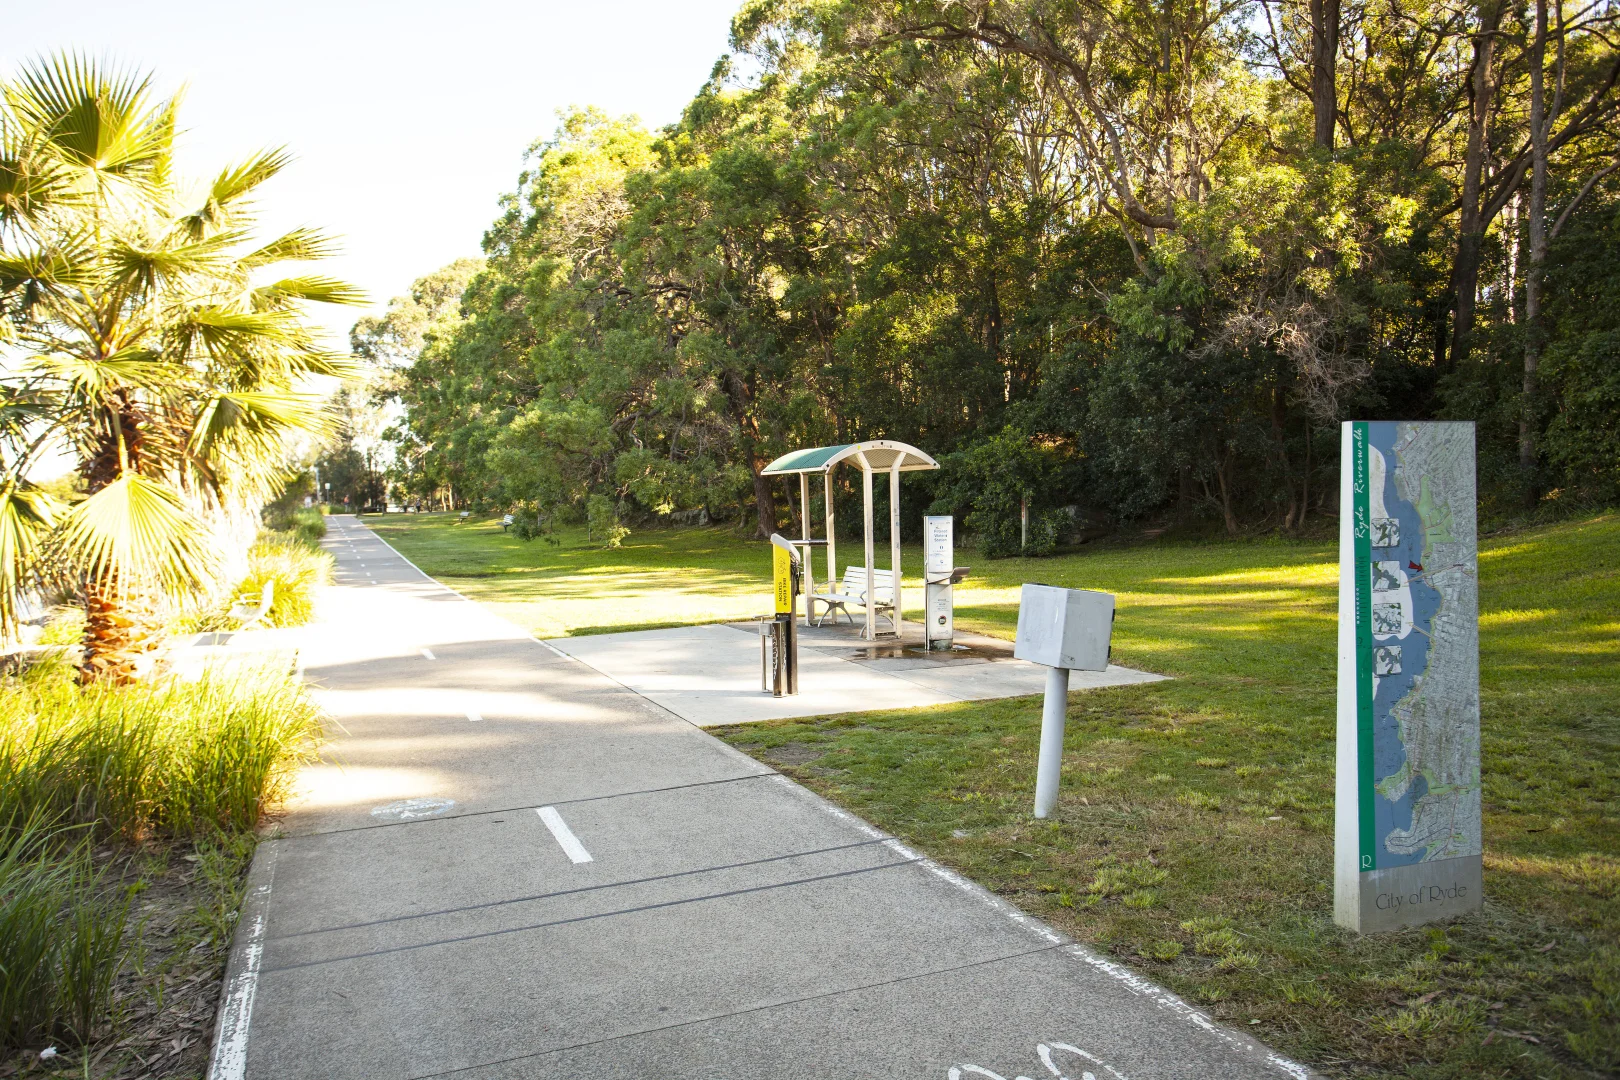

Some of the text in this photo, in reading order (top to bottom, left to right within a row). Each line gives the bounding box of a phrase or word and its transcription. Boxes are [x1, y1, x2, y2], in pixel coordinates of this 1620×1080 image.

[1354, 427, 1369, 539] Ryde Riverwalk
[1375, 881, 1467, 914] City of Ryde
